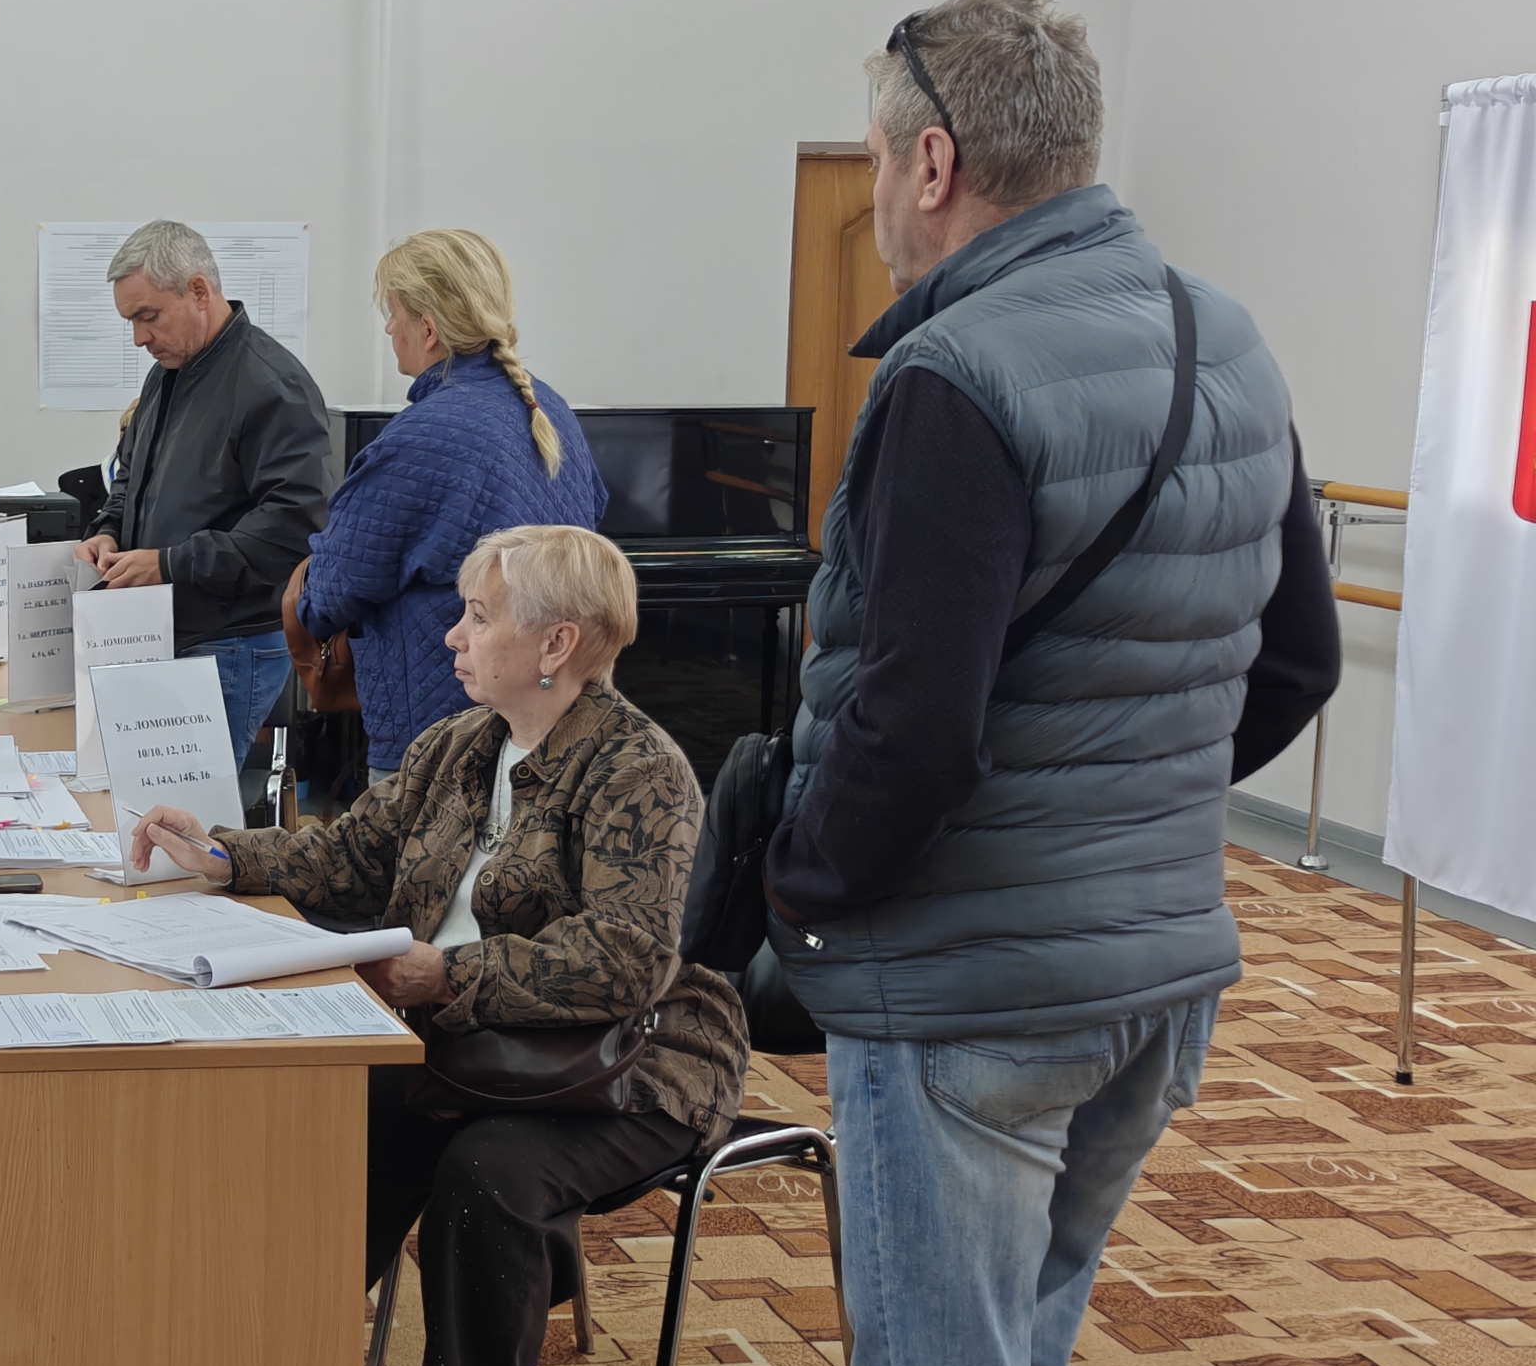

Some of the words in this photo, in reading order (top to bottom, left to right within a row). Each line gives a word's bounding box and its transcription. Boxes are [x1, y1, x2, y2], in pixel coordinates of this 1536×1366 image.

[100, 634, 162, 647] ЛОМОНОСОВА
[115, 722, 132, 732] Ул.
[134, 714, 212, 731] ЛОМОНОСОВА
[137, 747, 164, 759] 10/10,
[166, 745, 179, 756] 12,
[181, 743, 202, 754] 12/1,
[141, 777, 154, 787] 14,
[156, 775, 177, 786] 14А,
[179, 772, 198, 783] 14Б,
[200, 770, 211, 780] 16
